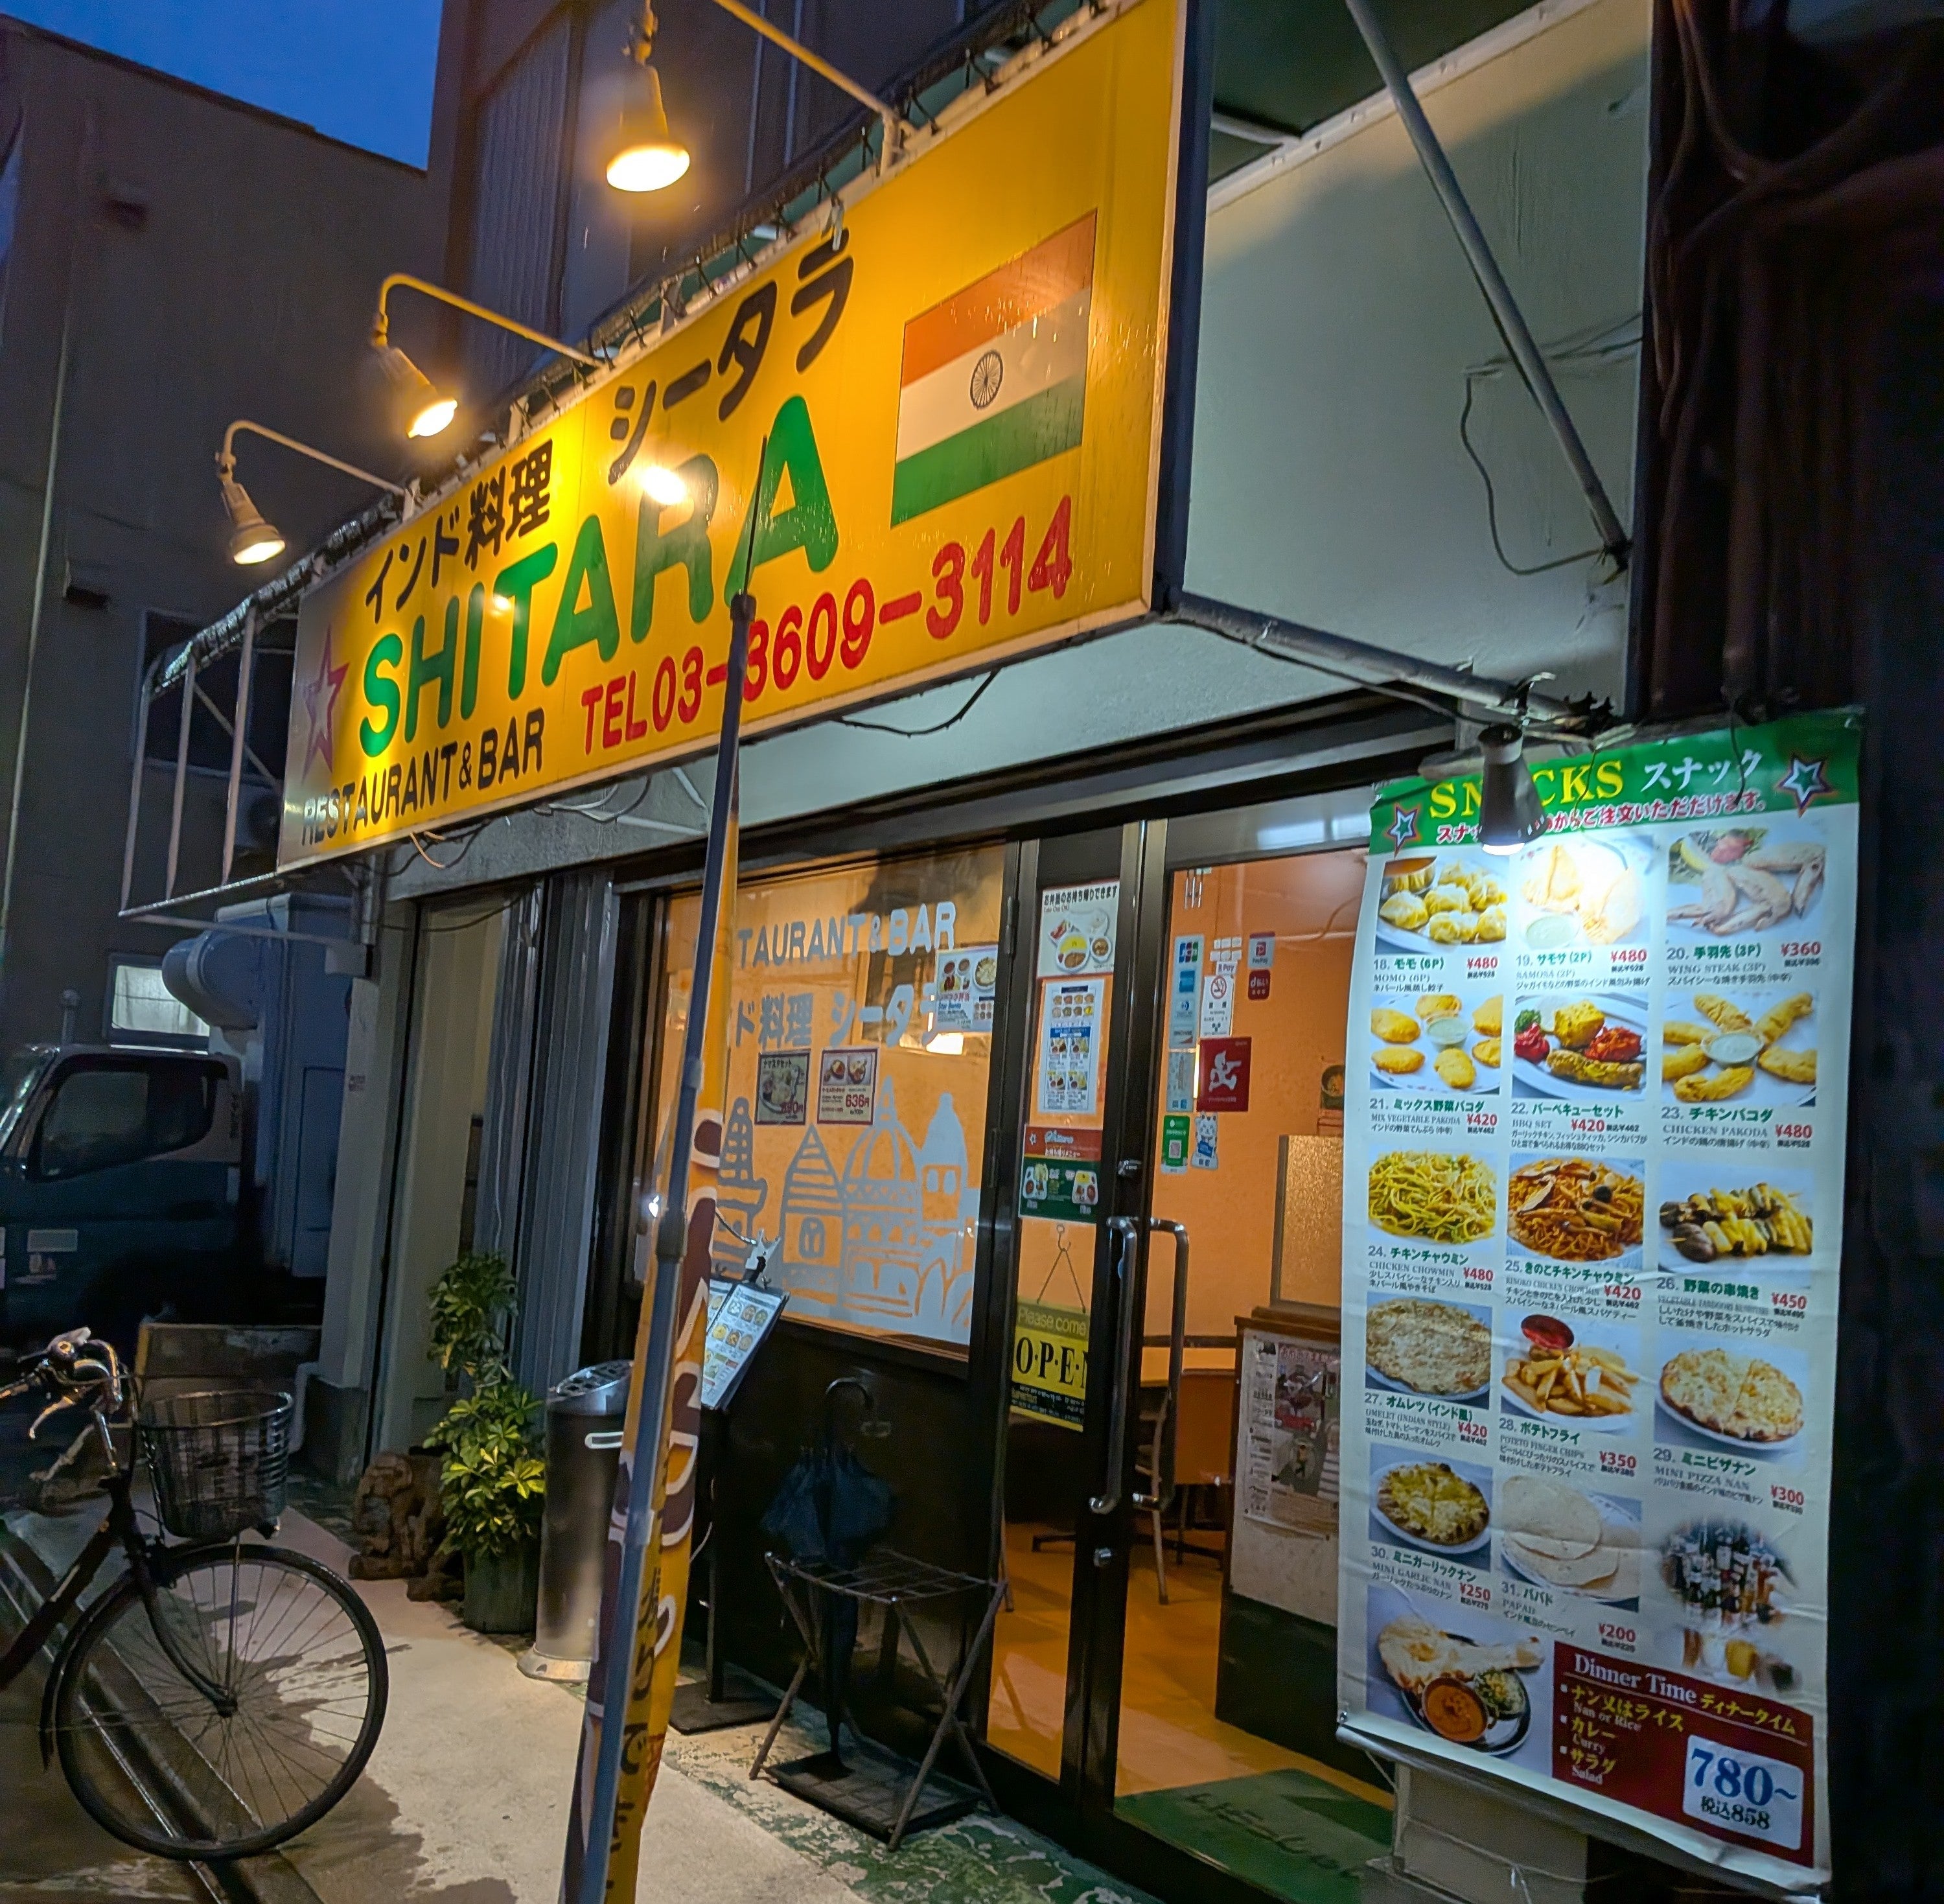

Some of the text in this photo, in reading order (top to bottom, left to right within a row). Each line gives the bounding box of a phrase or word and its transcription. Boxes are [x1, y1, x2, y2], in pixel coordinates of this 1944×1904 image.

[609, 228, 853, 485] シータラ
[364, 439, 553, 623] インド料理
[360, 395, 839, 758] SHITARA
[302, 708, 545, 846] RESTAURANT&BAR
[1429, 749, 1762, 818] SNCKS スナック
[1610, 948, 1648, 962] ¥480
[1666, 947, 1689, 960] 20.
[1781, 942, 1821, 957] ¥360
[1374, 958, 1390, 971] 18.
[1394, 957, 1417, 970] モモ
[1466, 957, 1498, 969] ¥480
[1516, 955, 1533, 966] 19.
[1536, 953, 1567, 966] サモサ
[1374, 974, 1406, 982] MOMO
[1369, 1098, 1389, 1110] 21.
[1510, 1102, 1625, 1119] 22. バーベキューセット
[1466, 1113, 1498, 1126] ¥420
[1660, 1106, 1685, 1120] 23.
[1571, 1119, 1606, 1132] ¥420
[1775, 1123, 1812, 1139] ¥480
[1367, 1244, 1469, 1266] 24. チキンチャウミン
[1463, 1266, 1494, 1283] ¥480
[1505, 1259, 1522, 1273] 25.
[1656, 1276, 1679, 1291] 26.
[1604, 1284, 1641, 1301] ¥420
[1771, 1292, 1807, 1310] ¥450
[1364, 1392, 1382, 1406] 27.
[1385, 1395, 1425, 1413] オムレツ
[1458, 1421, 1488, 1438] ¥420
[1499, 1417, 1517, 1432] 28.
[1599, 1450, 1637, 1469] ¥350
[1770, 1483, 1805, 1506] ¥300
[1371, 1546, 1389, 1561] 30.
[1459, 1581, 1491, 1601] ¥250
[1501, 1581, 1519, 1597] 31.
[1598, 1622, 1636, 1643] ¥200
[1574, 1652, 1796, 1736] Dinner Time ディナータイム
[1571, 1684, 1684, 1732] ナン又はライス
[1571, 1716, 1617, 1739] カレー
[1570, 1747, 1617, 1774] サラダ
[1700, 1795, 1770, 1830] 税込858
